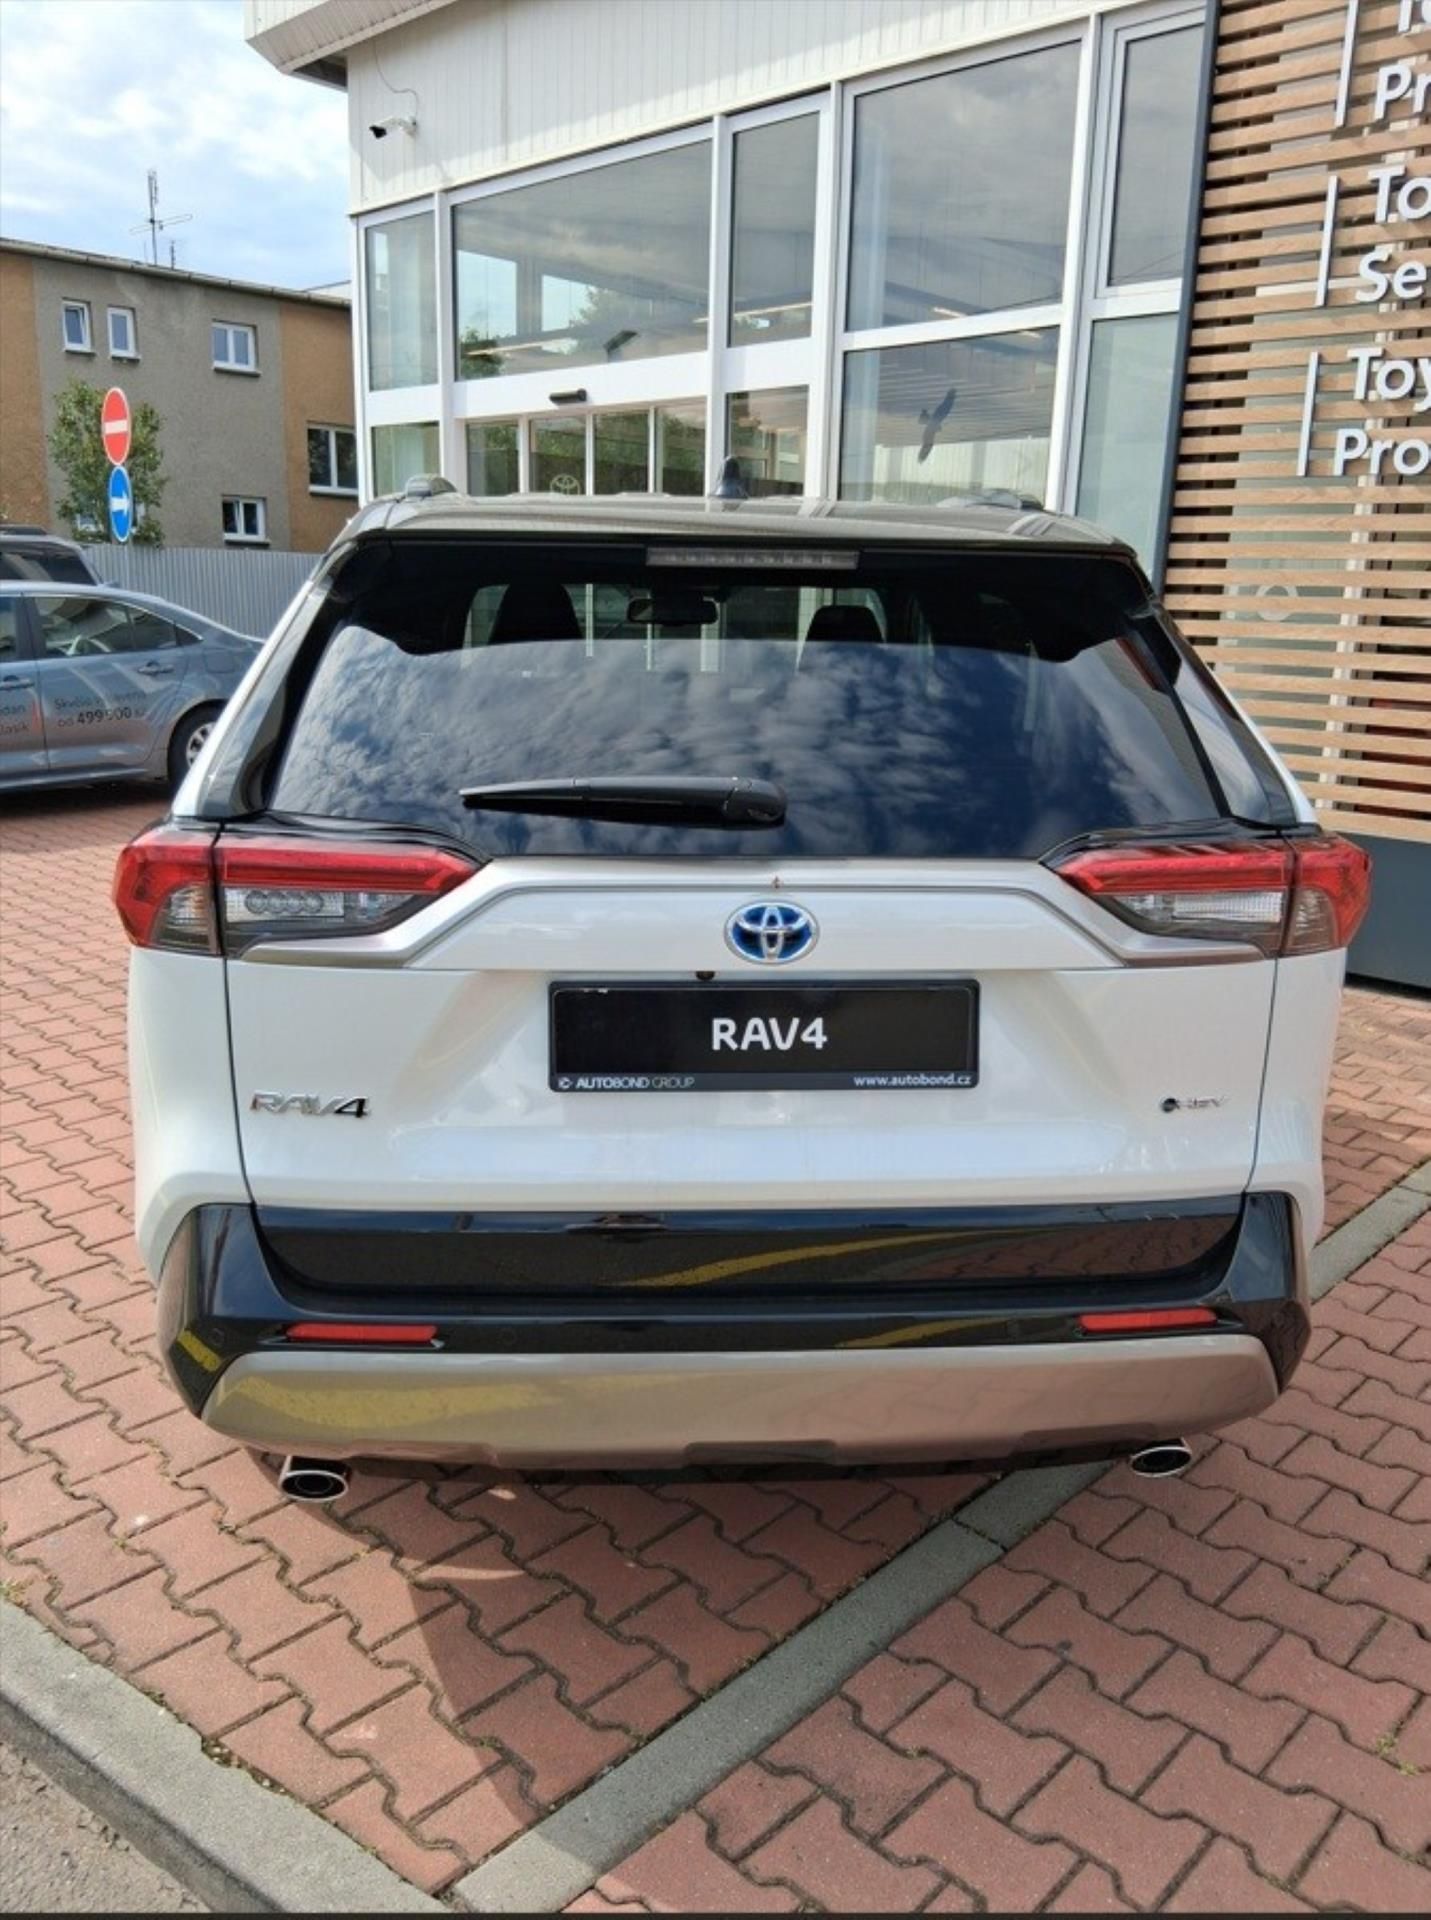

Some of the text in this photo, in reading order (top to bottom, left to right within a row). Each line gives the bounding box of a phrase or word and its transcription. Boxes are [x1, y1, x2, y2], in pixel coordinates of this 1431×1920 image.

[712, 1017, 828, 1051] RAV4
[575, 1076, 696, 1089] AUTOBOND GROUP
[853, 1072, 972, 1087] www.autobond.cz
[250, 1090, 371, 1118] RAV4
